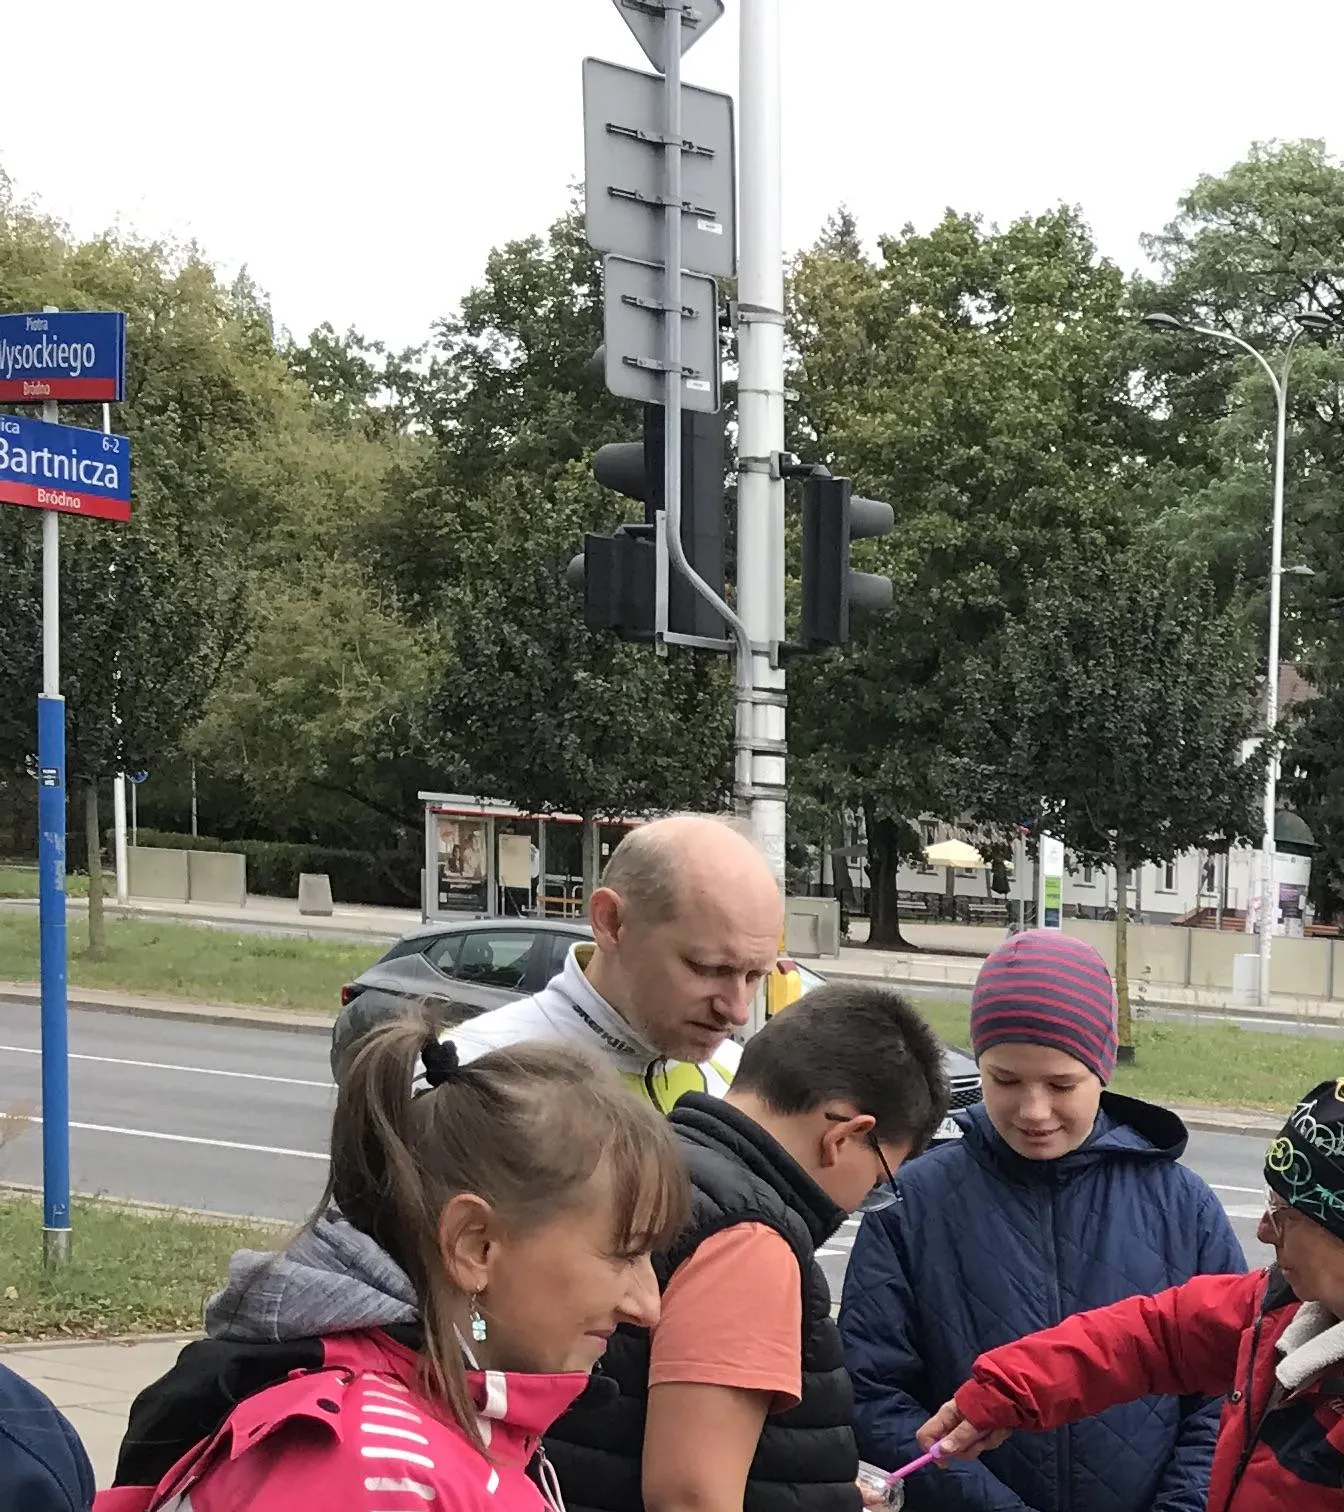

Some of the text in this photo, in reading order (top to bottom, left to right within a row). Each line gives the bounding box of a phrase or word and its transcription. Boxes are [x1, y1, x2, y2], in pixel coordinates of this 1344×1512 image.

[26, 316, 48, 331] Piotra
[102, 436, 120, 454] 6-2
[37, 488, 81, 509] Bródno
